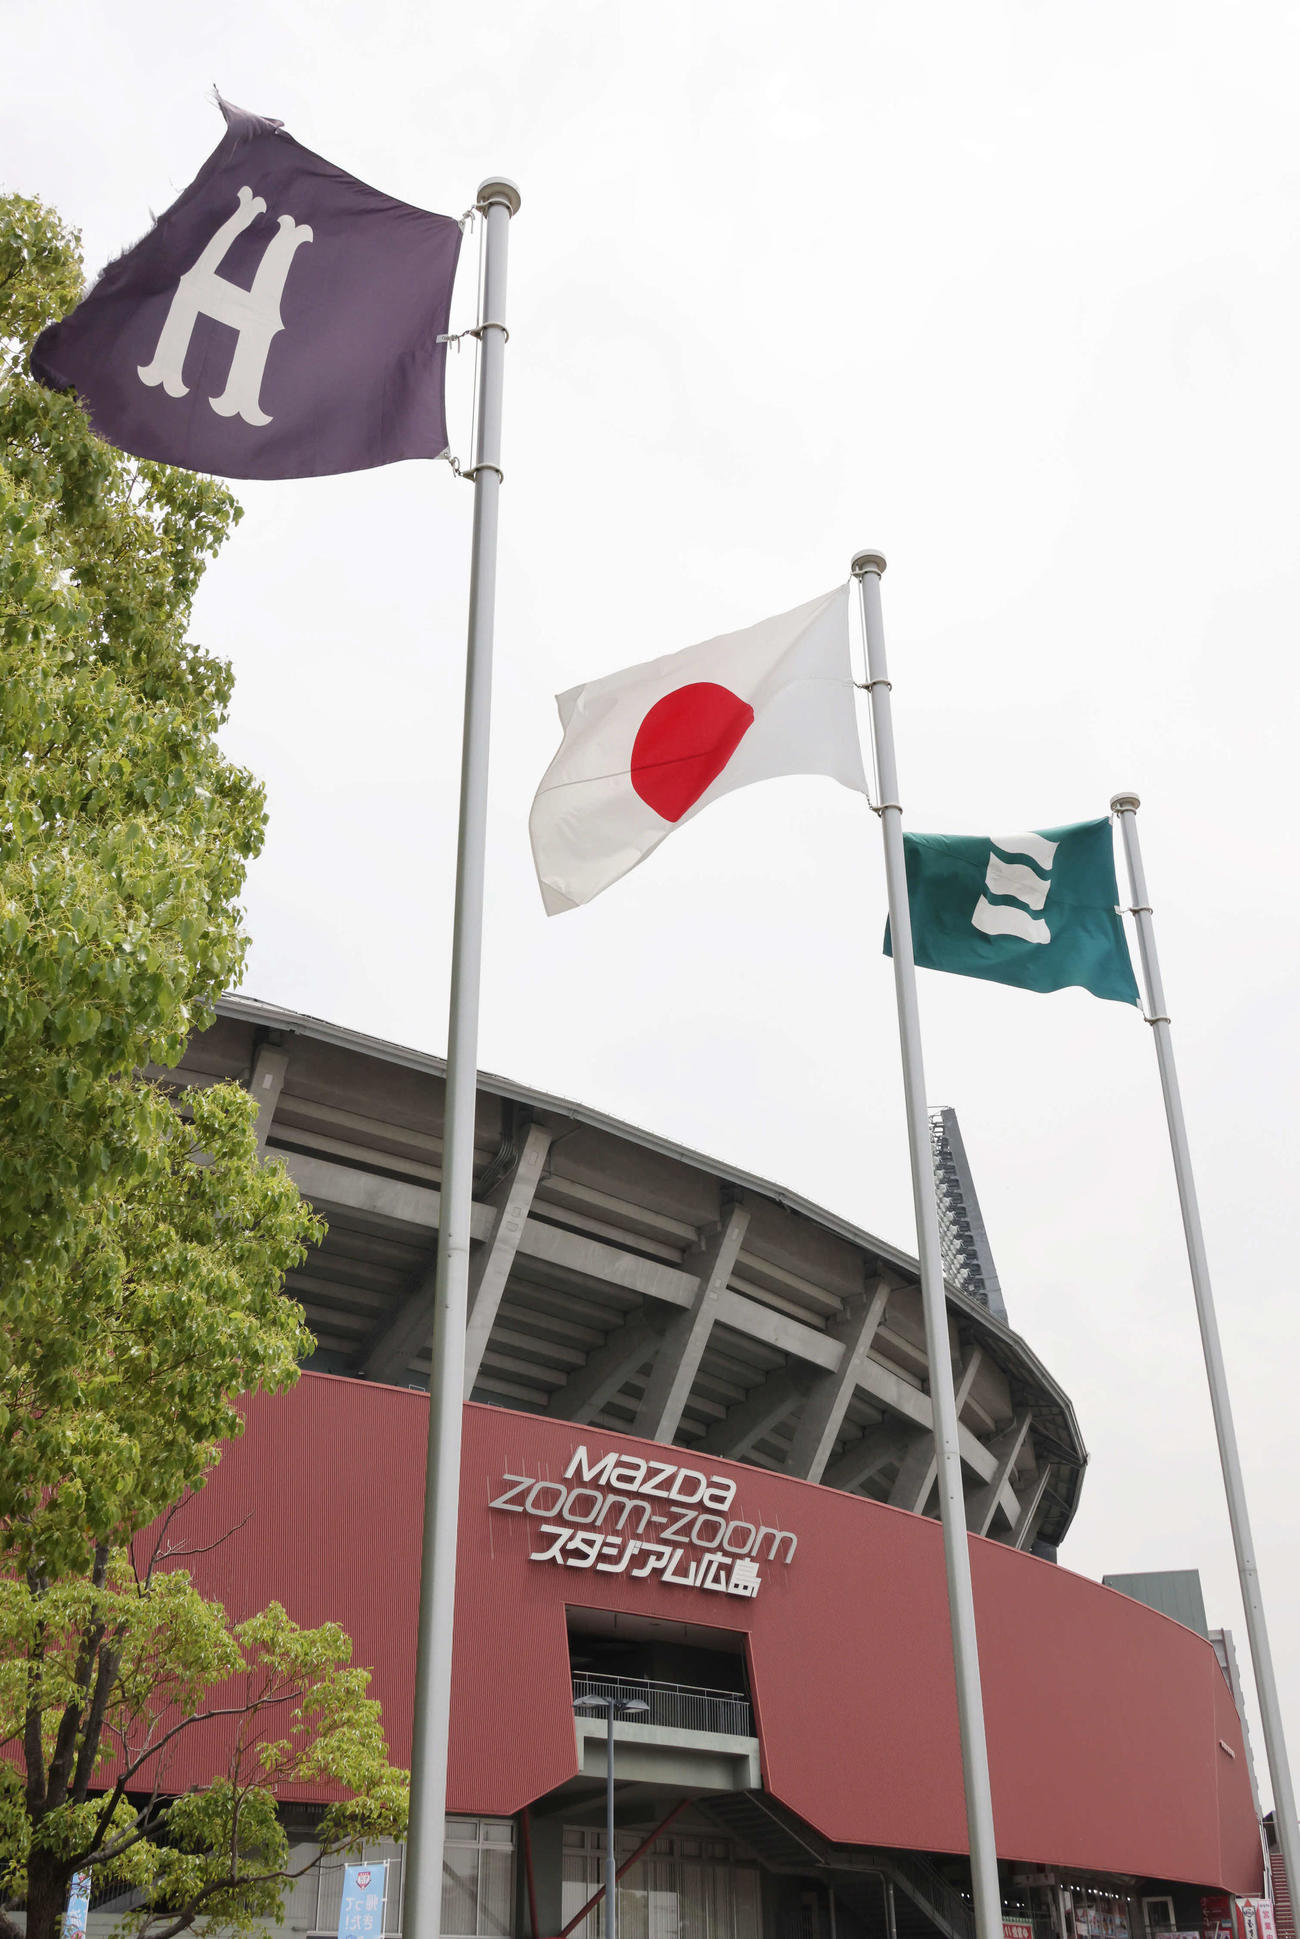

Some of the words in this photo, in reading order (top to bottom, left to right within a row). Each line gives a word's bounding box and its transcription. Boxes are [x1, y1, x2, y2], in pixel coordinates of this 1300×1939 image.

[137, 185, 314, 427] H
[529, 1524, 762, 1598] スタジアム広島
